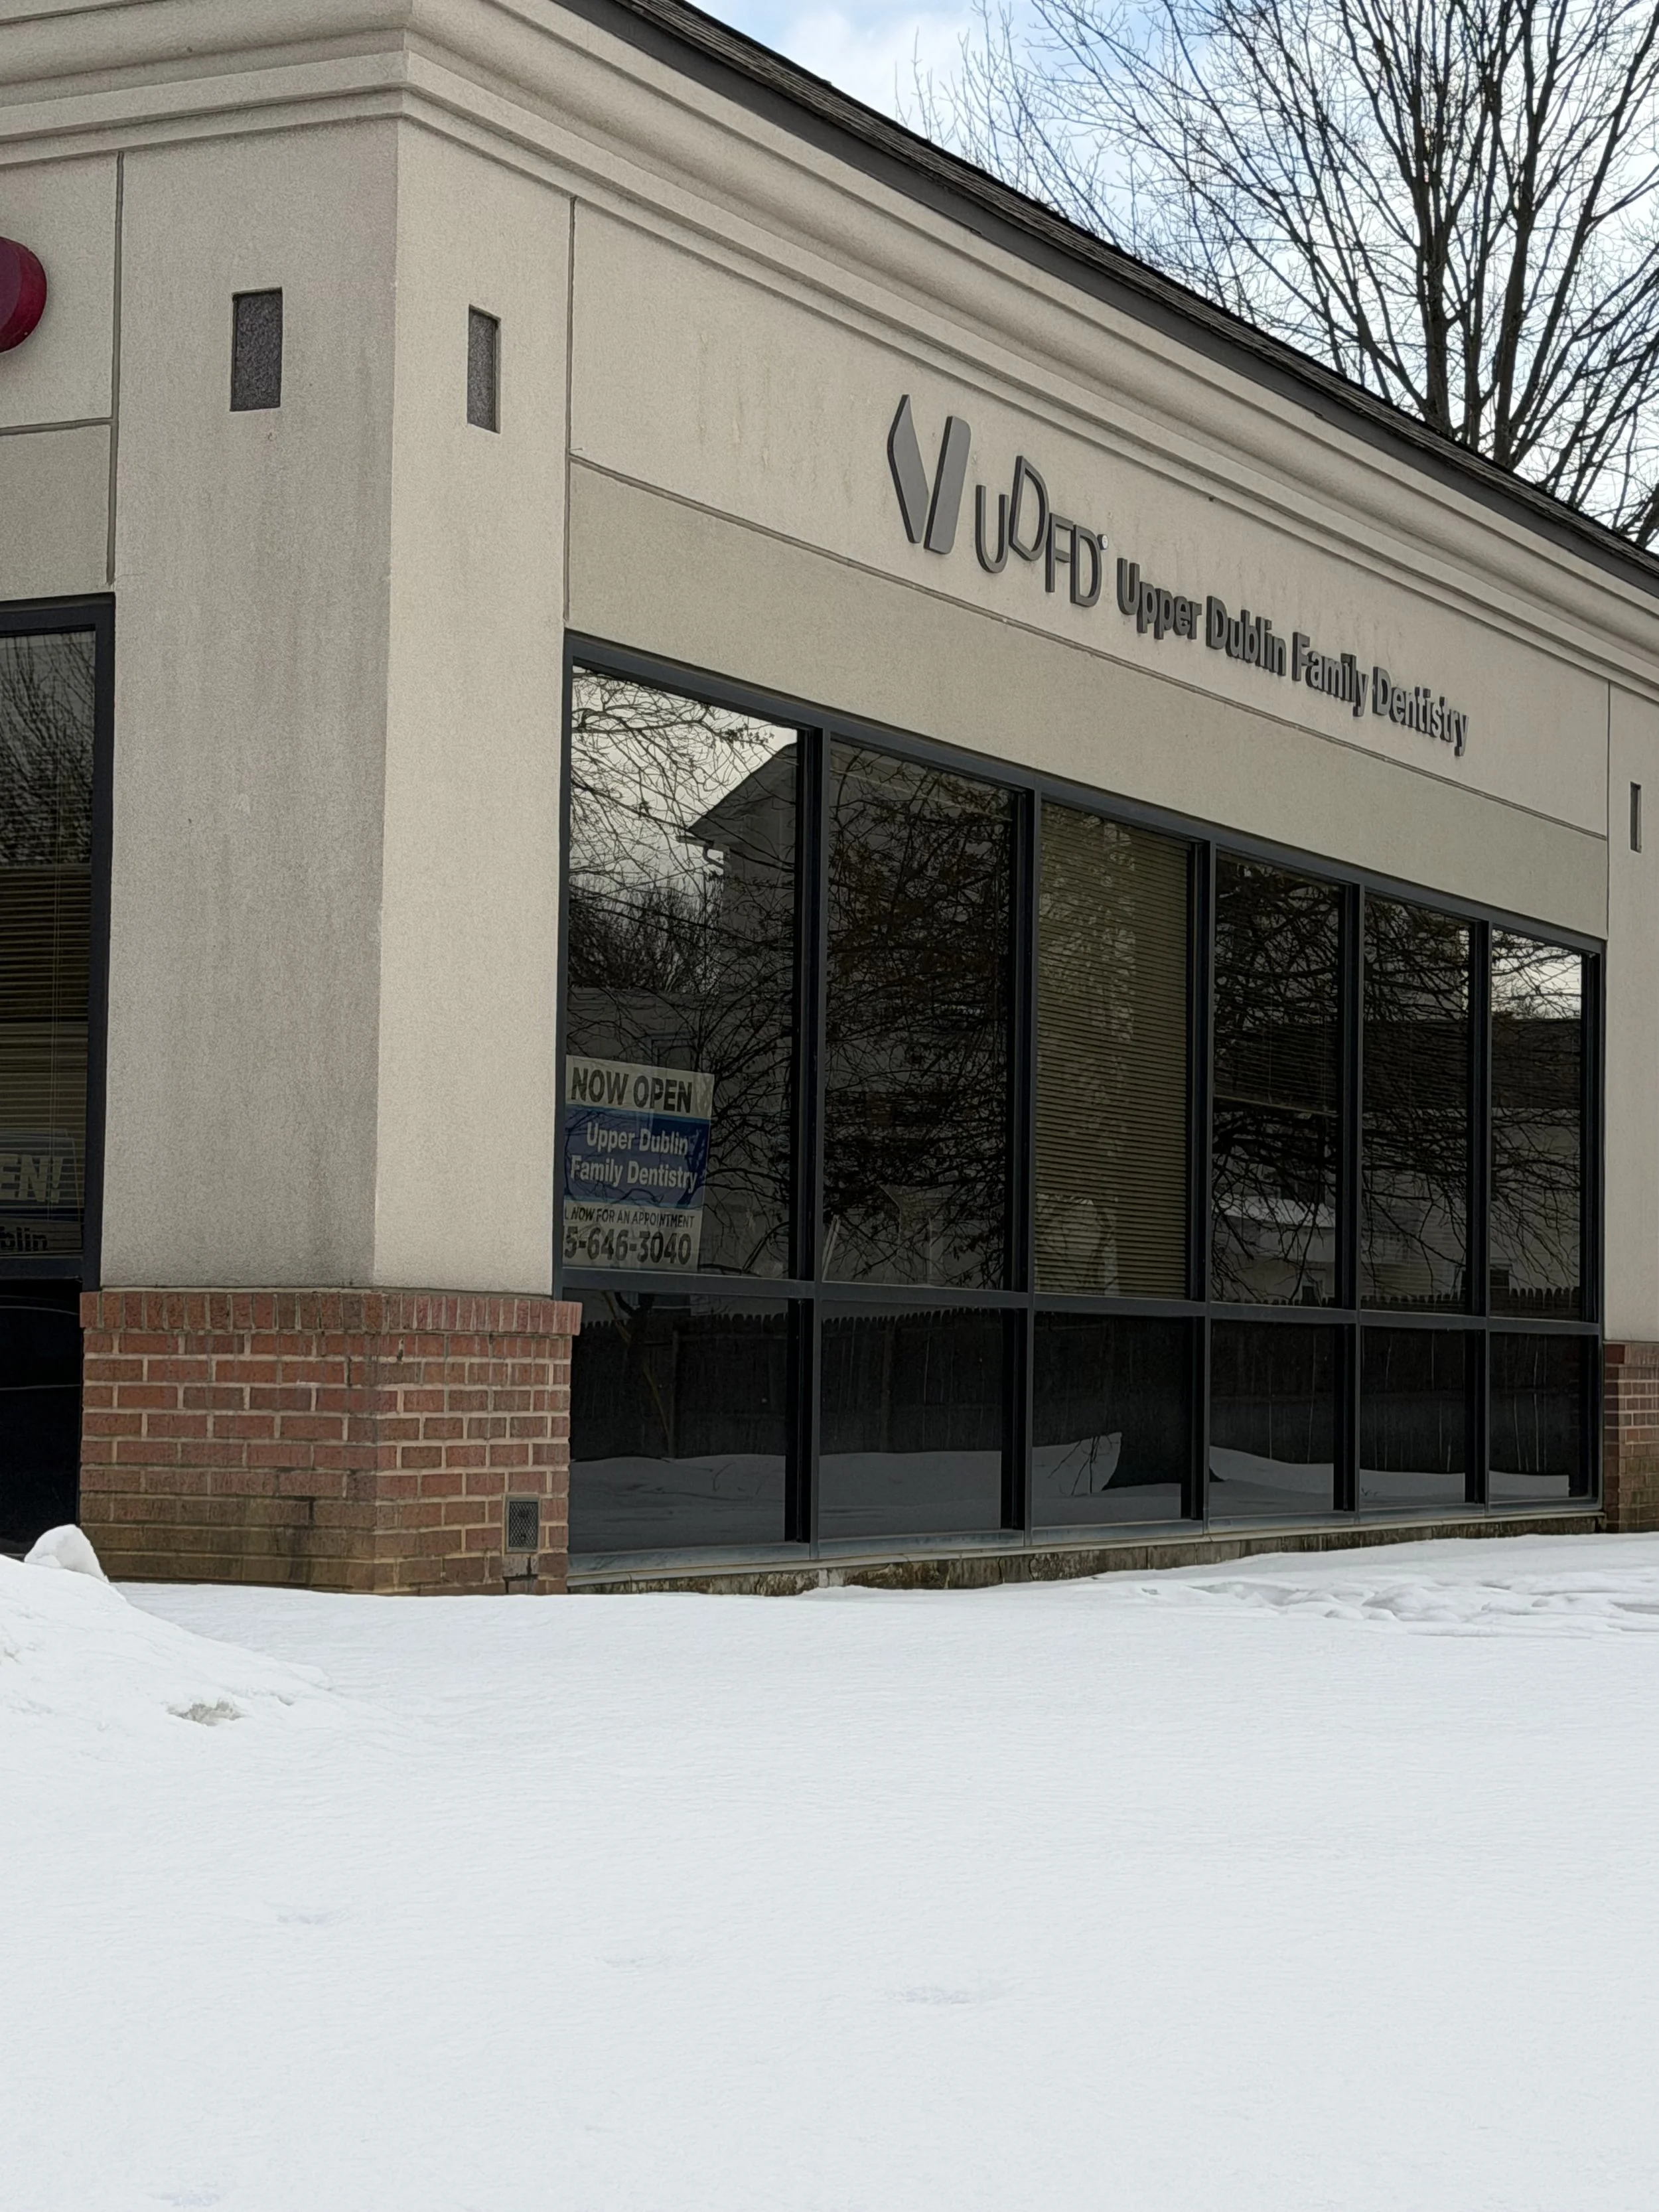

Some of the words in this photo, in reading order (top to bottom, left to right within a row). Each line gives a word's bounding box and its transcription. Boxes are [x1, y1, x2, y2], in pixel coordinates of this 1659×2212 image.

[1117, 557, 1202, 640] Upper
[1205, 595, 1286, 676] Dublin
[1291, 631, 1369, 717] Family
[1372, 666, 1469, 757] Dentistry
[571, 1066, 629, 1106] NOW
[633, 1074, 693, 1114] OPEN
[586, 1121, 636, 1153] Upper
[638, 1128, 688, 1157] Dublin
[569, 1154, 624, 1187] Family
[627, 1159, 699, 1194] Dentistry
[571, 1206, 595, 1221] NOW
[597, 1209, 615, 1223] FOR
[617, 1211, 630, 1224] AN
[632, 1211, 695, 1228] APPOINTMENT
[564, 1226, 692, 1266] 5-646-3040
